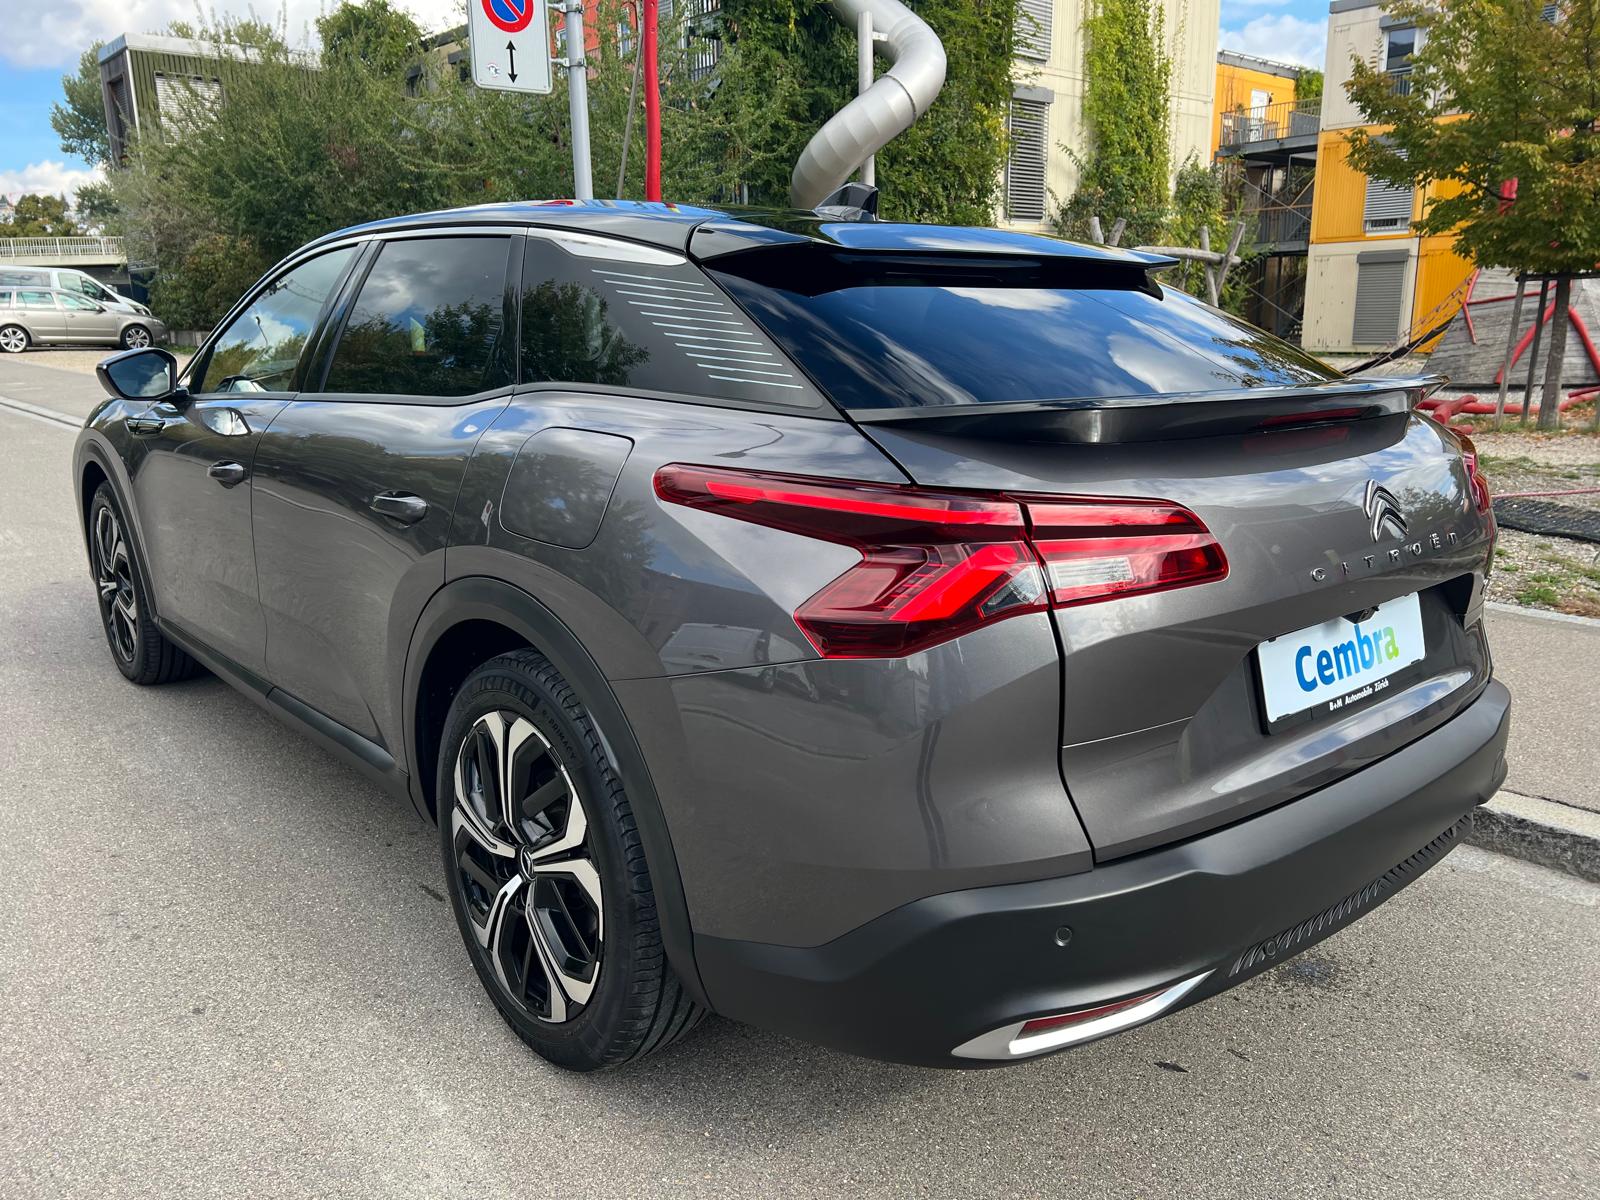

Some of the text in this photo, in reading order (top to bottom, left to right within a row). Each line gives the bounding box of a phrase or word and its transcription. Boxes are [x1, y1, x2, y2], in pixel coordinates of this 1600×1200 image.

[1310, 532, 1458, 582] CITROËN
[1295, 624, 1399, 692] Cembra
[1329, 678, 1389, 711] B+M Automobile Zürich
